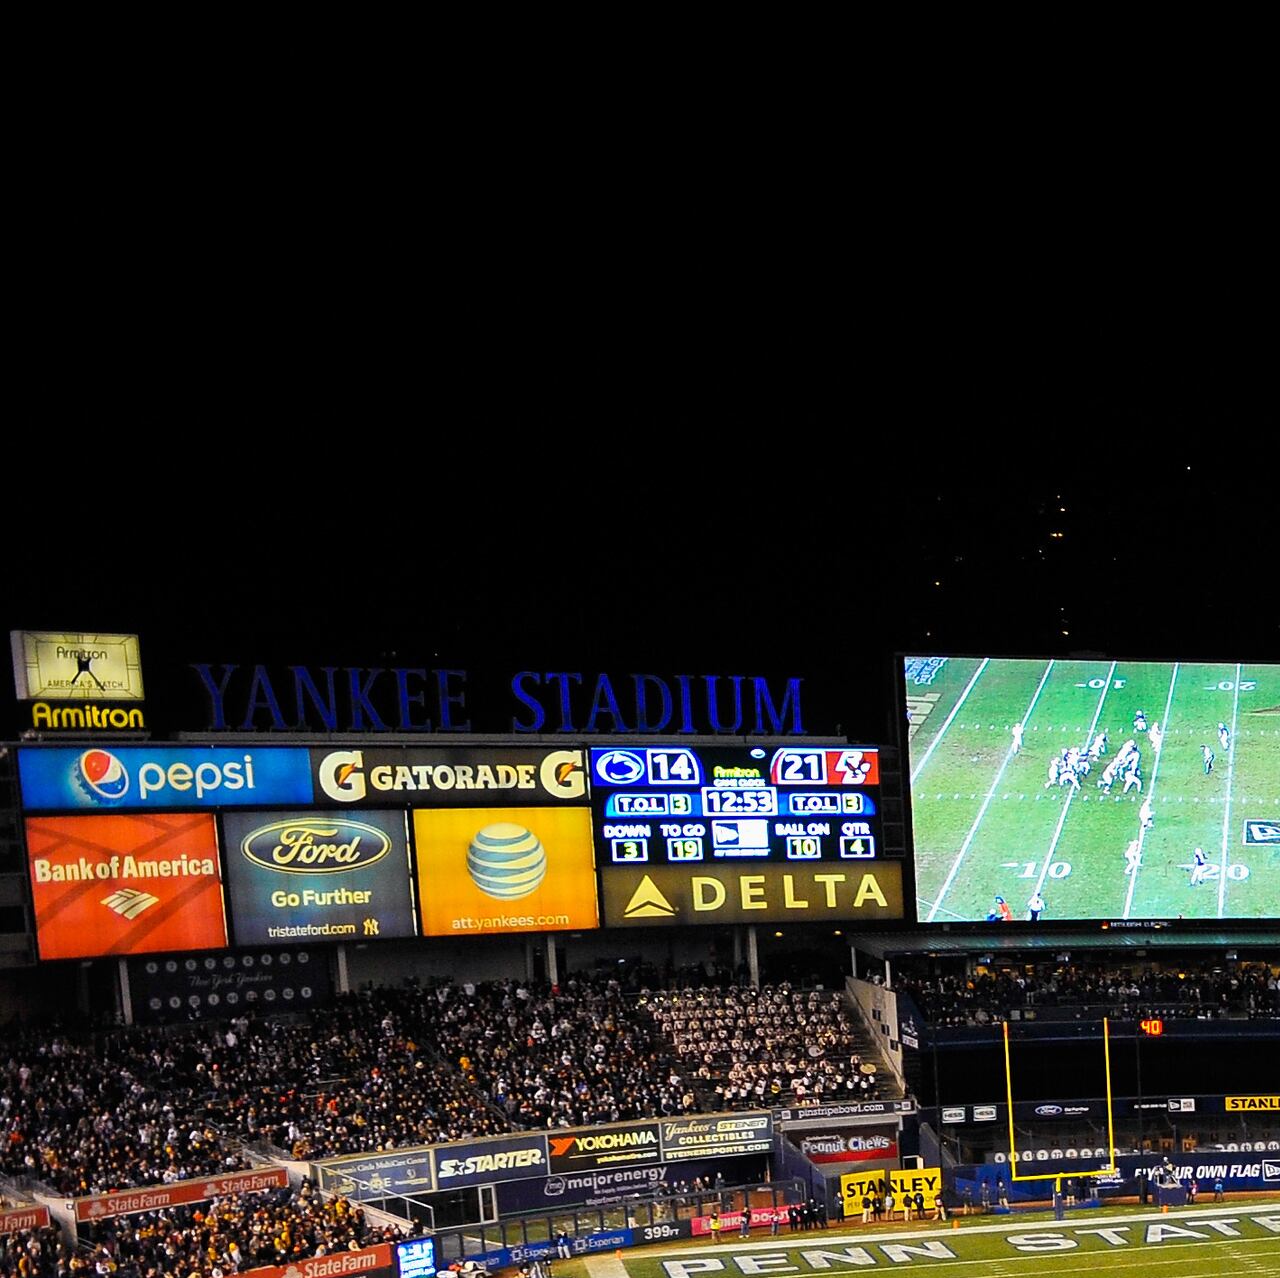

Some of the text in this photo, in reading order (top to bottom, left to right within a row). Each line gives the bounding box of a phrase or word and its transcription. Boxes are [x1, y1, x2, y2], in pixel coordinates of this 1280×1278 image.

[190, 663, 807, 735] YANKEE STADIUM
[32, 702, 144, 728] Armitron
[319, 750, 586, 802] G GATORADE G
[652, 754, 692, 780] 14
[784, 754, 819, 780] 21
[138, 755, 256, 799] pepsi
[673, 795, 687, 810] 3
[708, 791, 772, 813] 12:53
[845, 795, 859, 809] 3
[603, 824, 651, 838] DOWN
[660, 824, 706, 837] TO GO
[774, 823, 830, 836] BALL ON
[841, 822, 870, 836] QTR
[272, 826, 363, 865] Ford
[624, 842, 638, 859] 3
[673, 840, 694, 857] 19
[792, 839, 815, 856] 10
[850, 839, 864, 855] 4
[34, 853, 215, 883] Bank of America
[1017, 861, 1073, 879] 10
[271, 889, 372, 908] Go Further
[691, 873, 888, 912] DELTA
[267, 923, 356, 938] tristateford.com
[451, 913, 570, 930] att.yankees.com
[797, 1103, 885, 1118] pinstripebowl.com
[663, 1119, 711, 1141] Yankees
[678, 1131, 755, 1145] COLLECTIBLES
[575, 1130, 658, 1151] YOKOHAMA
[801, 1134, 890, 1154] Peanut Chews
[464, 1148, 542, 1175] STARTER
[567, 1166, 668, 1190] majorenergy
[1196, 1163, 1261, 1179] OWN FLAG
